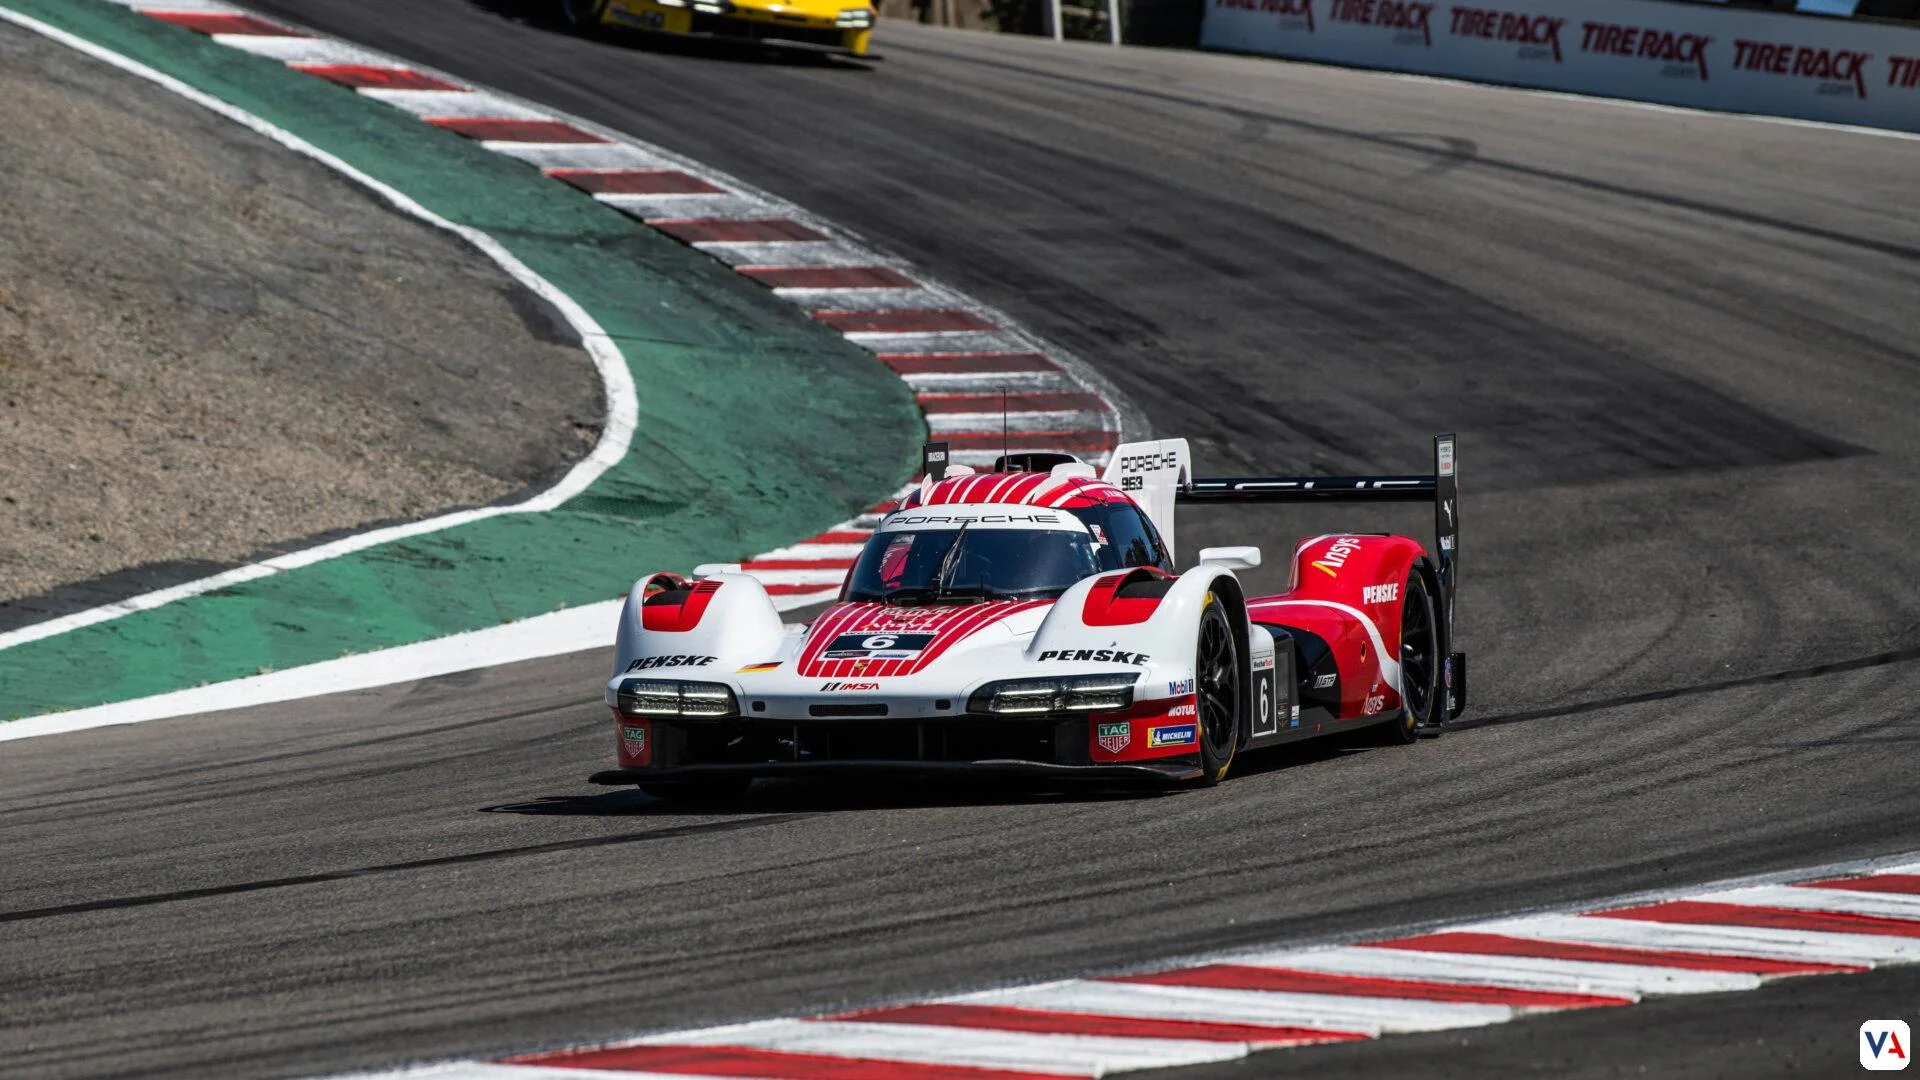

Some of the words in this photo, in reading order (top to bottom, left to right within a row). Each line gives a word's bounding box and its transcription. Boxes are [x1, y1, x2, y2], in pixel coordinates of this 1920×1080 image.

[1450, 6, 1499, 39] TIRE
[1498, 12, 1565, 63] RACK
[1582, 22, 1638, 57] TIRE
[1637, 28, 1710, 81] RACK
[1733, 39, 1793, 75] TIRE
[1792, 47, 1867, 98] RACK
[1121, 452, 1176, 473] PORSCHE
[888, 515, 1061, 525] PORSCHE
[1311, 538, 1361, 578] Ansys
[1362, 583, 1398, 605] PENSKE
[861, 634, 899, 649] 6
[626, 655, 718, 673] PENSKE
[1037, 650, 1150, 666] PENSKE
[840, 682, 880, 691] IMSA
[1169, 681, 1188, 695] Mobil
[1260, 677, 1268, 724] 6
[1168, 704, 1196, 717] MOTUL
[626, 729, 642, 740] TAG
[1101, 724, 1128, 735] TAG
[1162, 731, 1192, 740] MICHELIN
[625, 741, 644, 757] HEUER
[1100, 735, 1129, 751] HEUER
